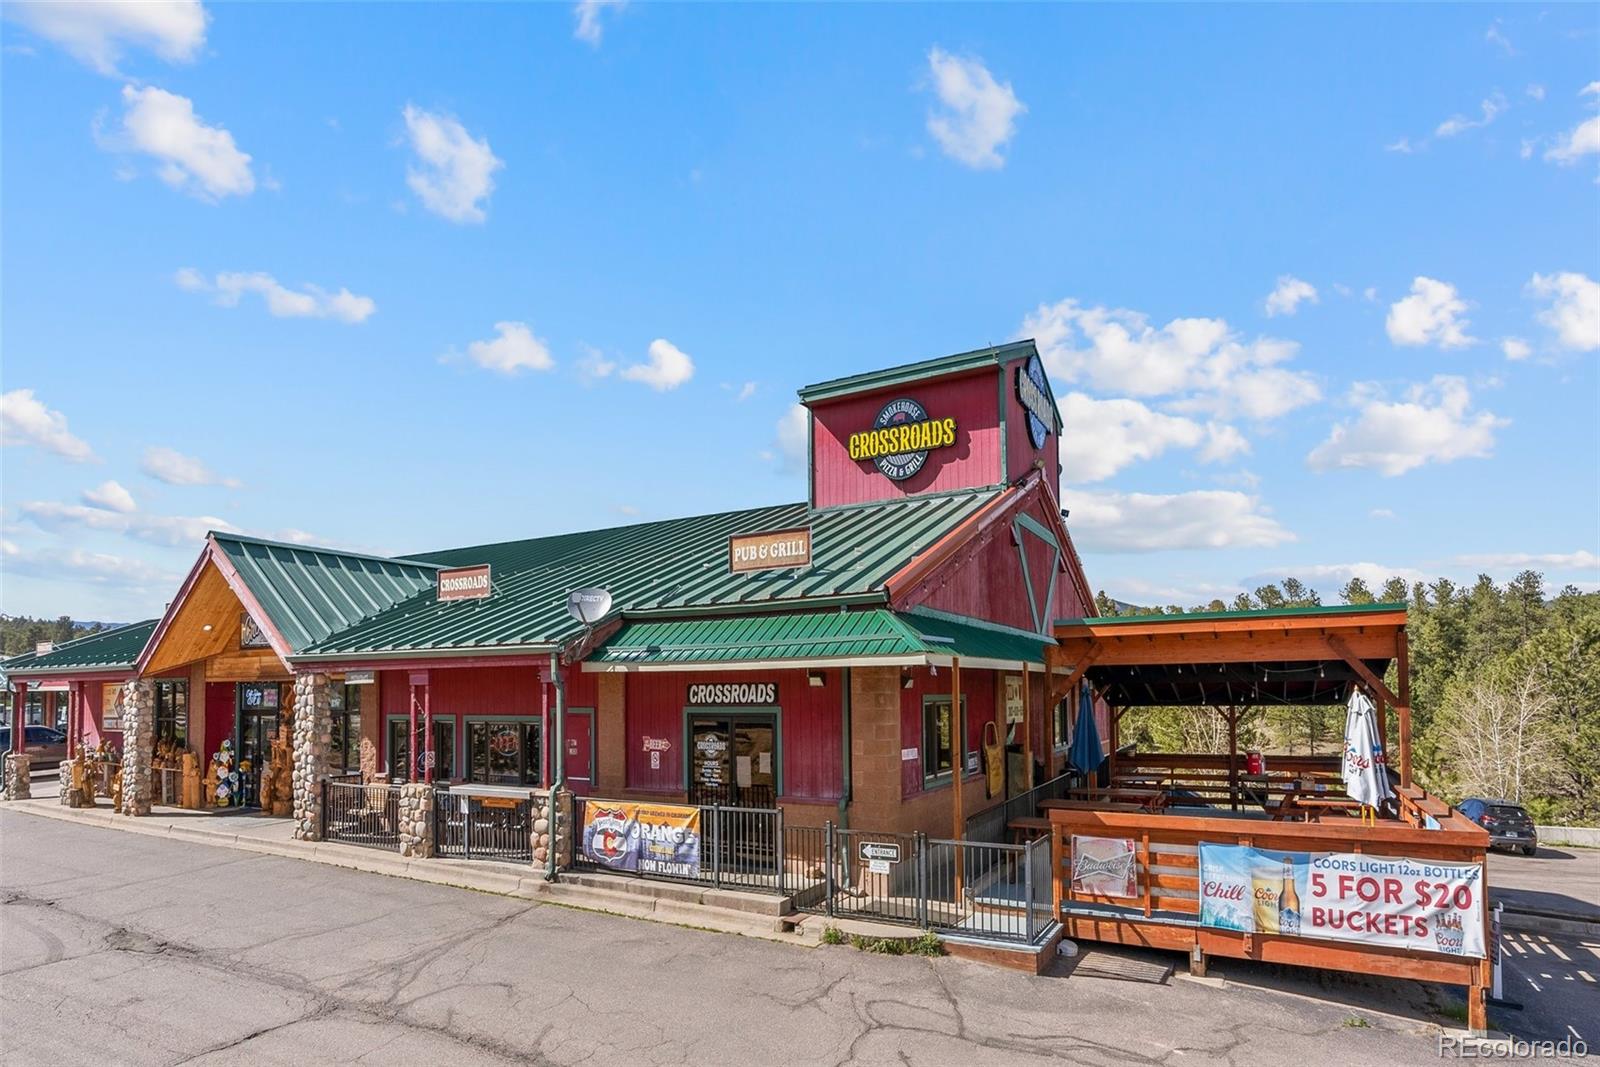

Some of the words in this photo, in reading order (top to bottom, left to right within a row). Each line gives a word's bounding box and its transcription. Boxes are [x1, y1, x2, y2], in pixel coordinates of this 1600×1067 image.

[880, 401, 920, 425] SMOKEHOUSE
[849, 418, 955, 460] CROSSROADS
[880, 459, 897, 477] PIZZA
[905, 455, 923, 475] GRILL
[735, 545, 757, 562] PUB
[759, 544, 768, 559] &
[770, 540, 807, 558] GRILL
[441, 575, 488, 591] CROSSROADS
[580, 594, 606, 602] IRECTV
[689, 683, 775, 704] CROSSROADS
[871, 848, 895, 857] ENTRANCE
[638, 859, 656, 871] NOW
[658, 861, 692, 876] FLOWIN'
[1313, 858, 1357, 872] COORS
[1360, 862, 1396, 875] LIGHT
[1398, 865, 1421, 876] 12oz
[1424, 866, 1480, 881] BOTTLES
[1202, 880, 1247, 901] Chill
[1254, 887, 1280, 900] Coor
[1312, 873, 1328, 898] 5
[1339, 875, 1404, 905] FOR
[1414, 879, 1473, 911] $20
[1257, 900, 1279, 908] LIGH
[1312, 907, 1429, 938] BUCKETS
